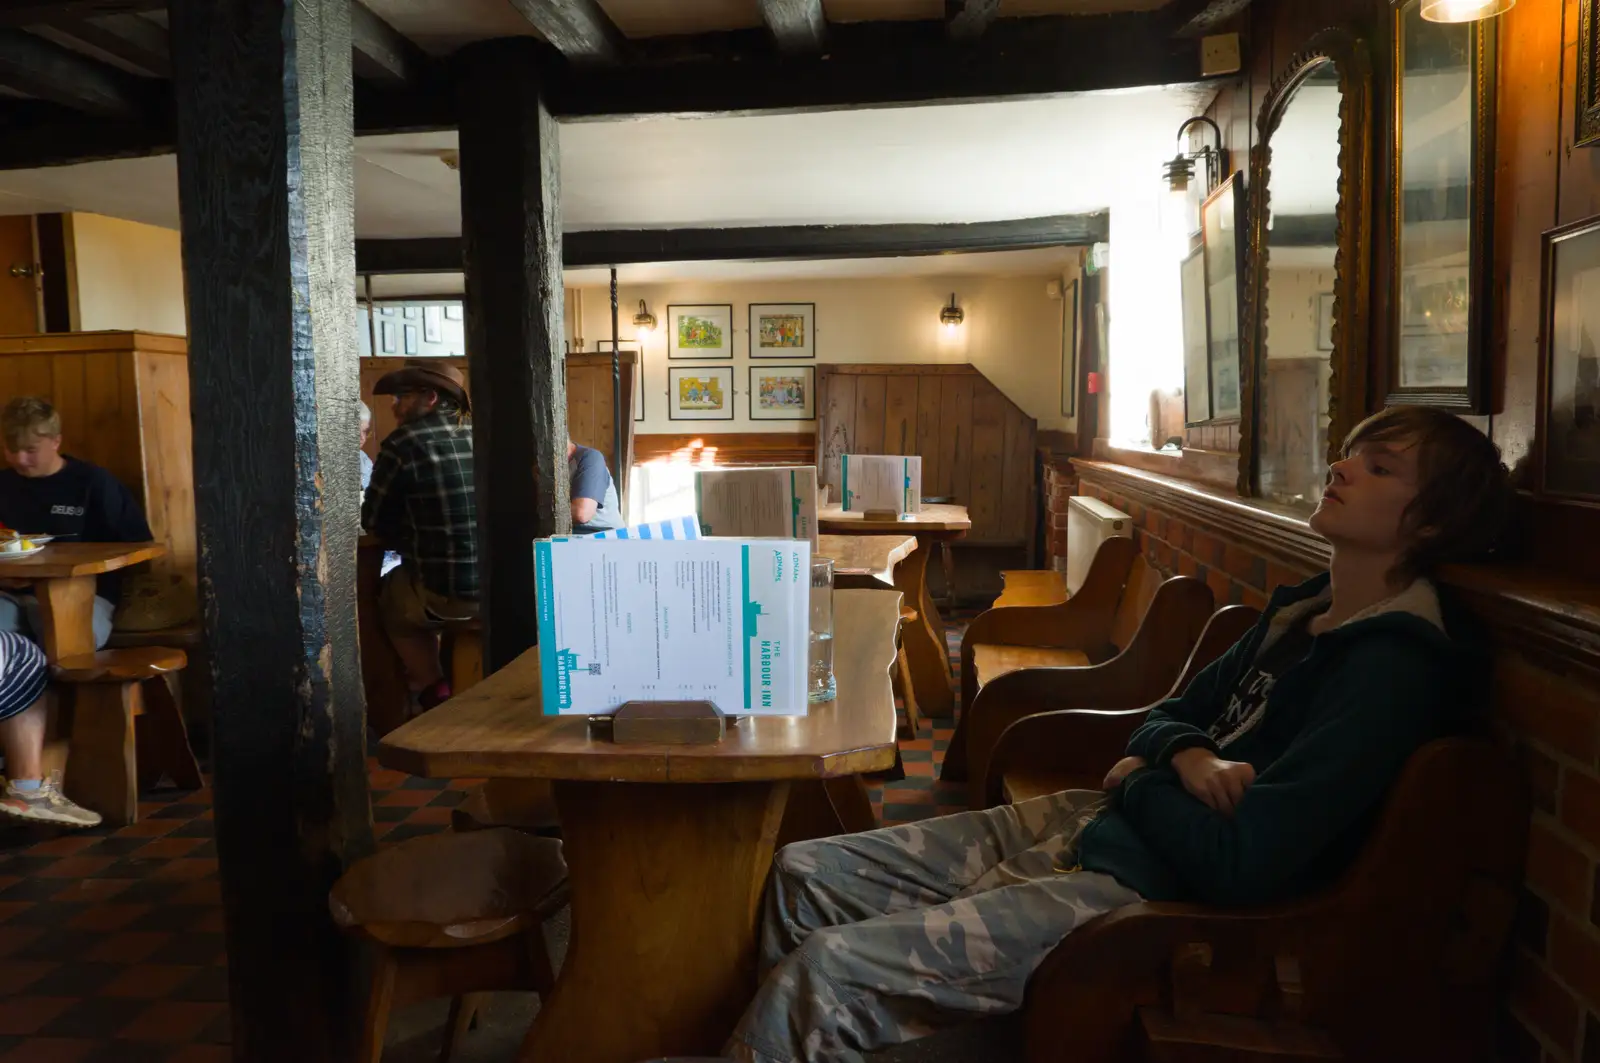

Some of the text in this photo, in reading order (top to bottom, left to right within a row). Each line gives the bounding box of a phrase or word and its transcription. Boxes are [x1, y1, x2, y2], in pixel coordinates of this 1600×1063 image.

[773, 549, 784, 582] ADNAMS
[558, 655, 566, 690] HARBOUR
[761, 640, 772, 707] HARBOUR INN
[559, 691, 567, 705] INN
